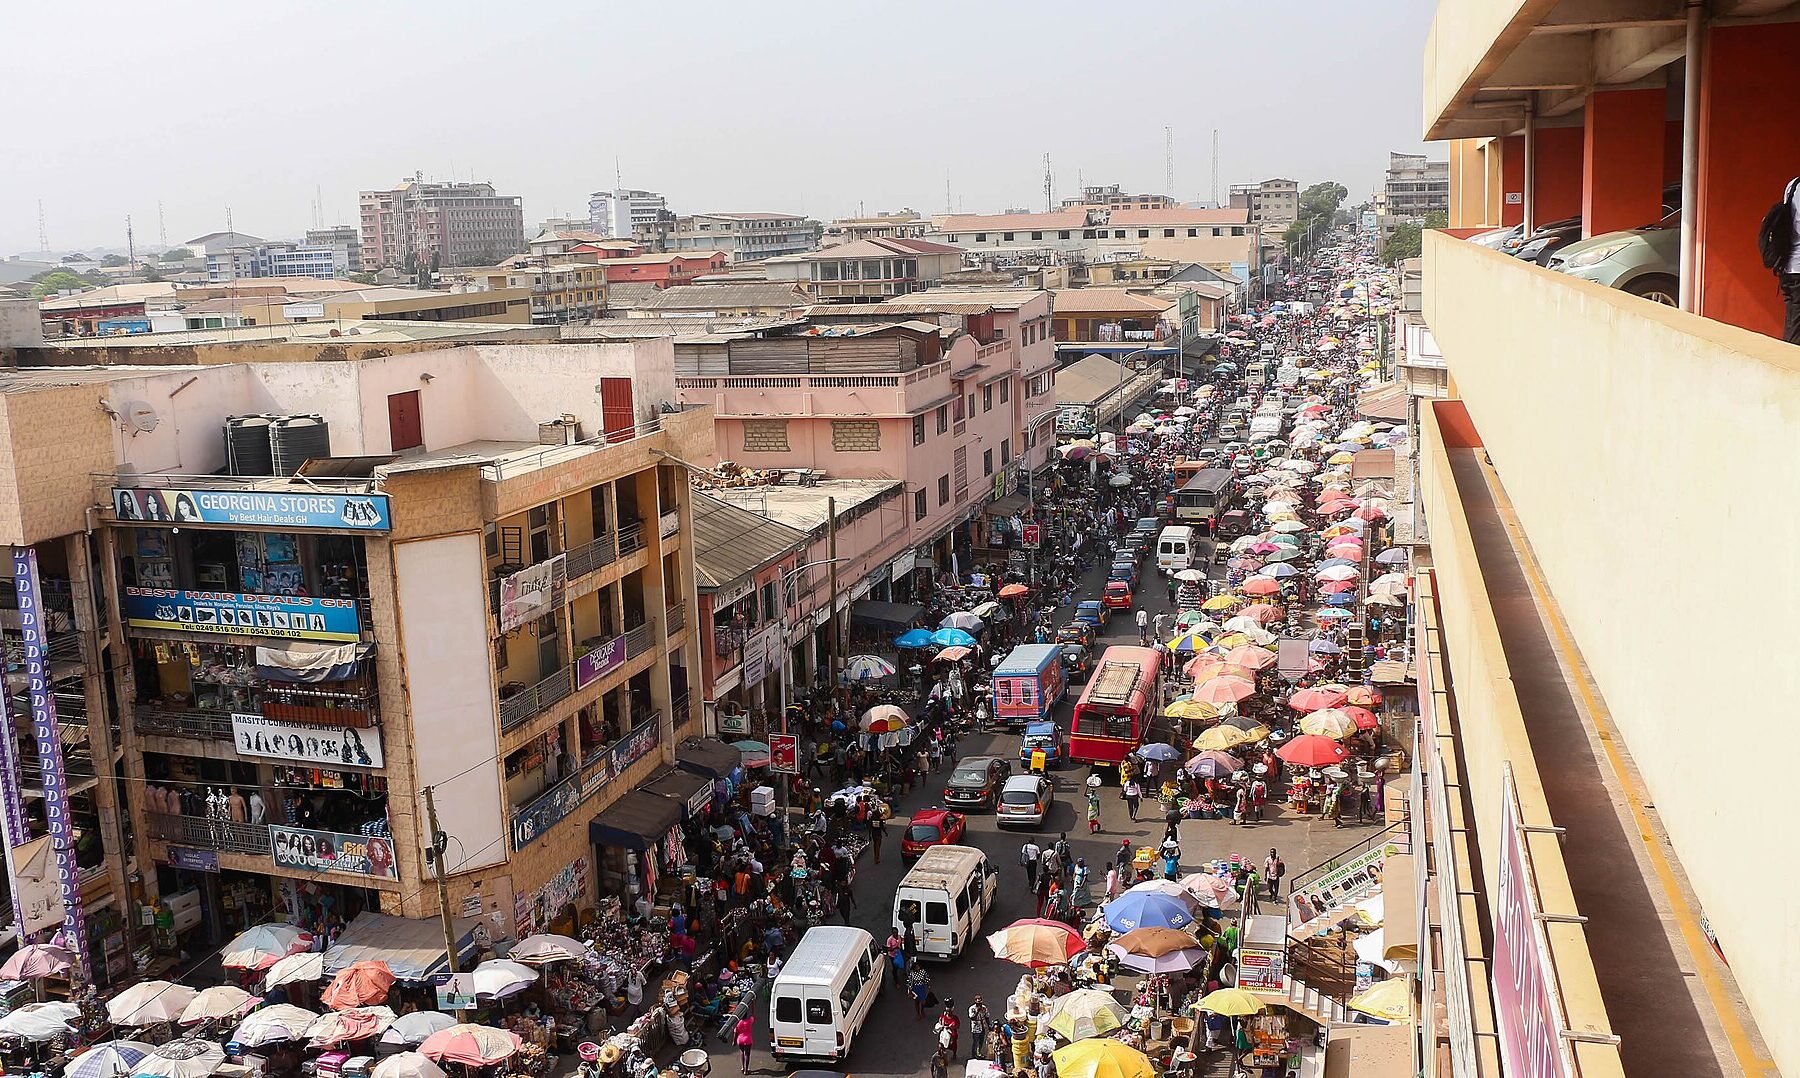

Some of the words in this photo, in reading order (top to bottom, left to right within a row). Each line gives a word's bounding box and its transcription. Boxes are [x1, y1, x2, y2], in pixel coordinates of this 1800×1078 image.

[200, 494, 277, 512] GEORGINA
[280, 497, 336, 514] STORES
[229, 512, 239, 522] by
[273, 515, 294, 523] Deals
[126, 586, 179, 599] BEST
[184, 590, 237, 603] HAIR
[243, 593, 313, 606] DEALS
[320, 598, 353, 608] GH
[1317, 866, 1350, 888] AFRIPRIDE
[1349, 859, 1364, 871] WIG
[1364, 849, 1382, 862] SHOP
[1120, 917, 1136, 928] tigo
[1170, 913, 1184, 925] tigo
